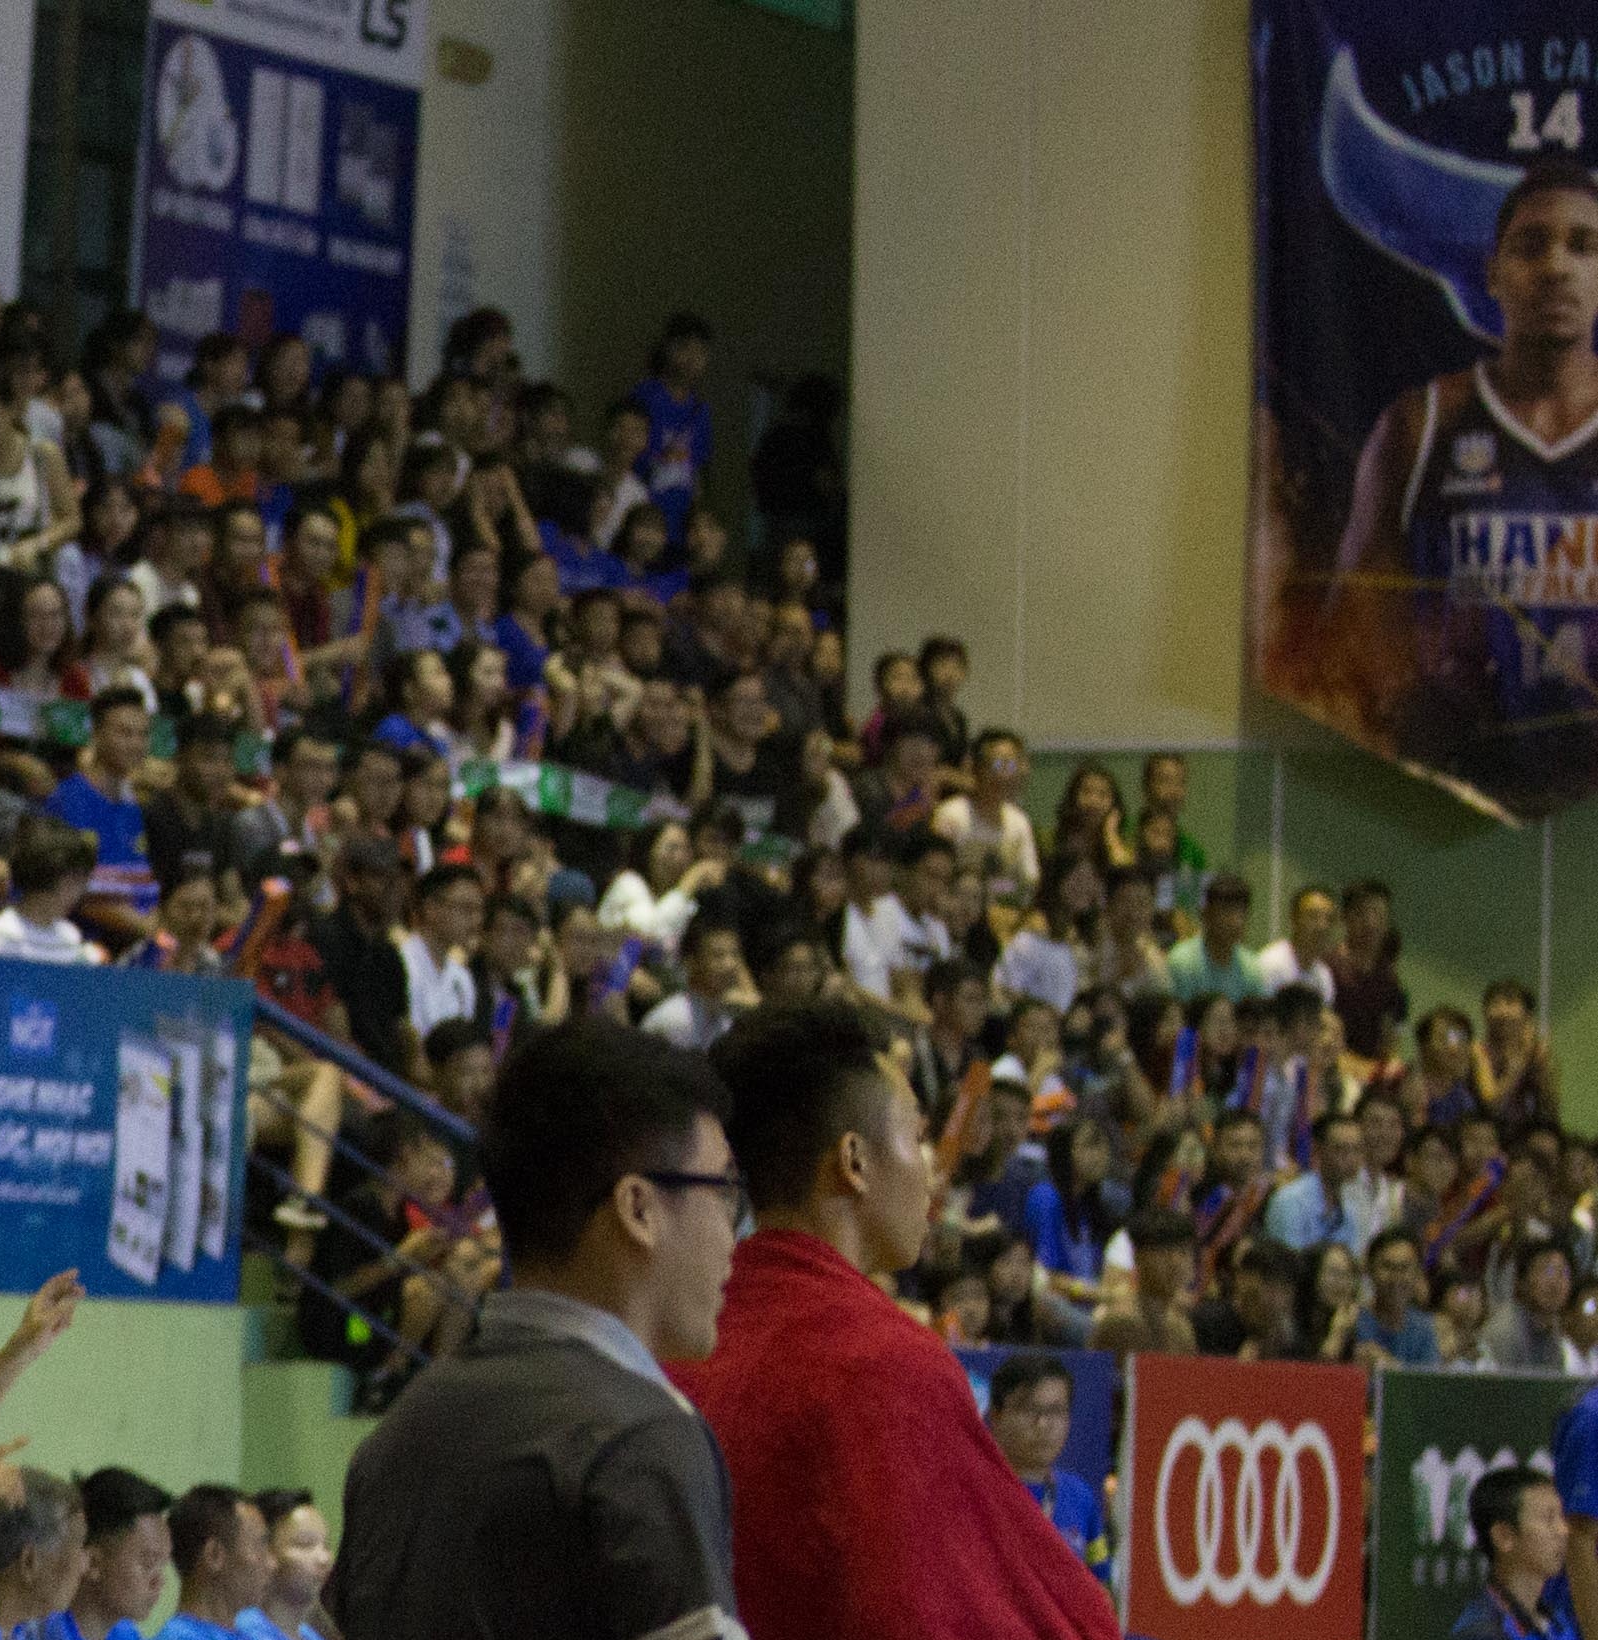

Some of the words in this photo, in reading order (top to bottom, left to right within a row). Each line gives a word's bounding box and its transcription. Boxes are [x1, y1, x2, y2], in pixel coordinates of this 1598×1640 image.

[1403, 40, 1525, 113] JASON
[1542, 38, 1598, 82] CA
[1507, 89, 1585, 150] 14
[1457, 512, 1598, 571] HAN
